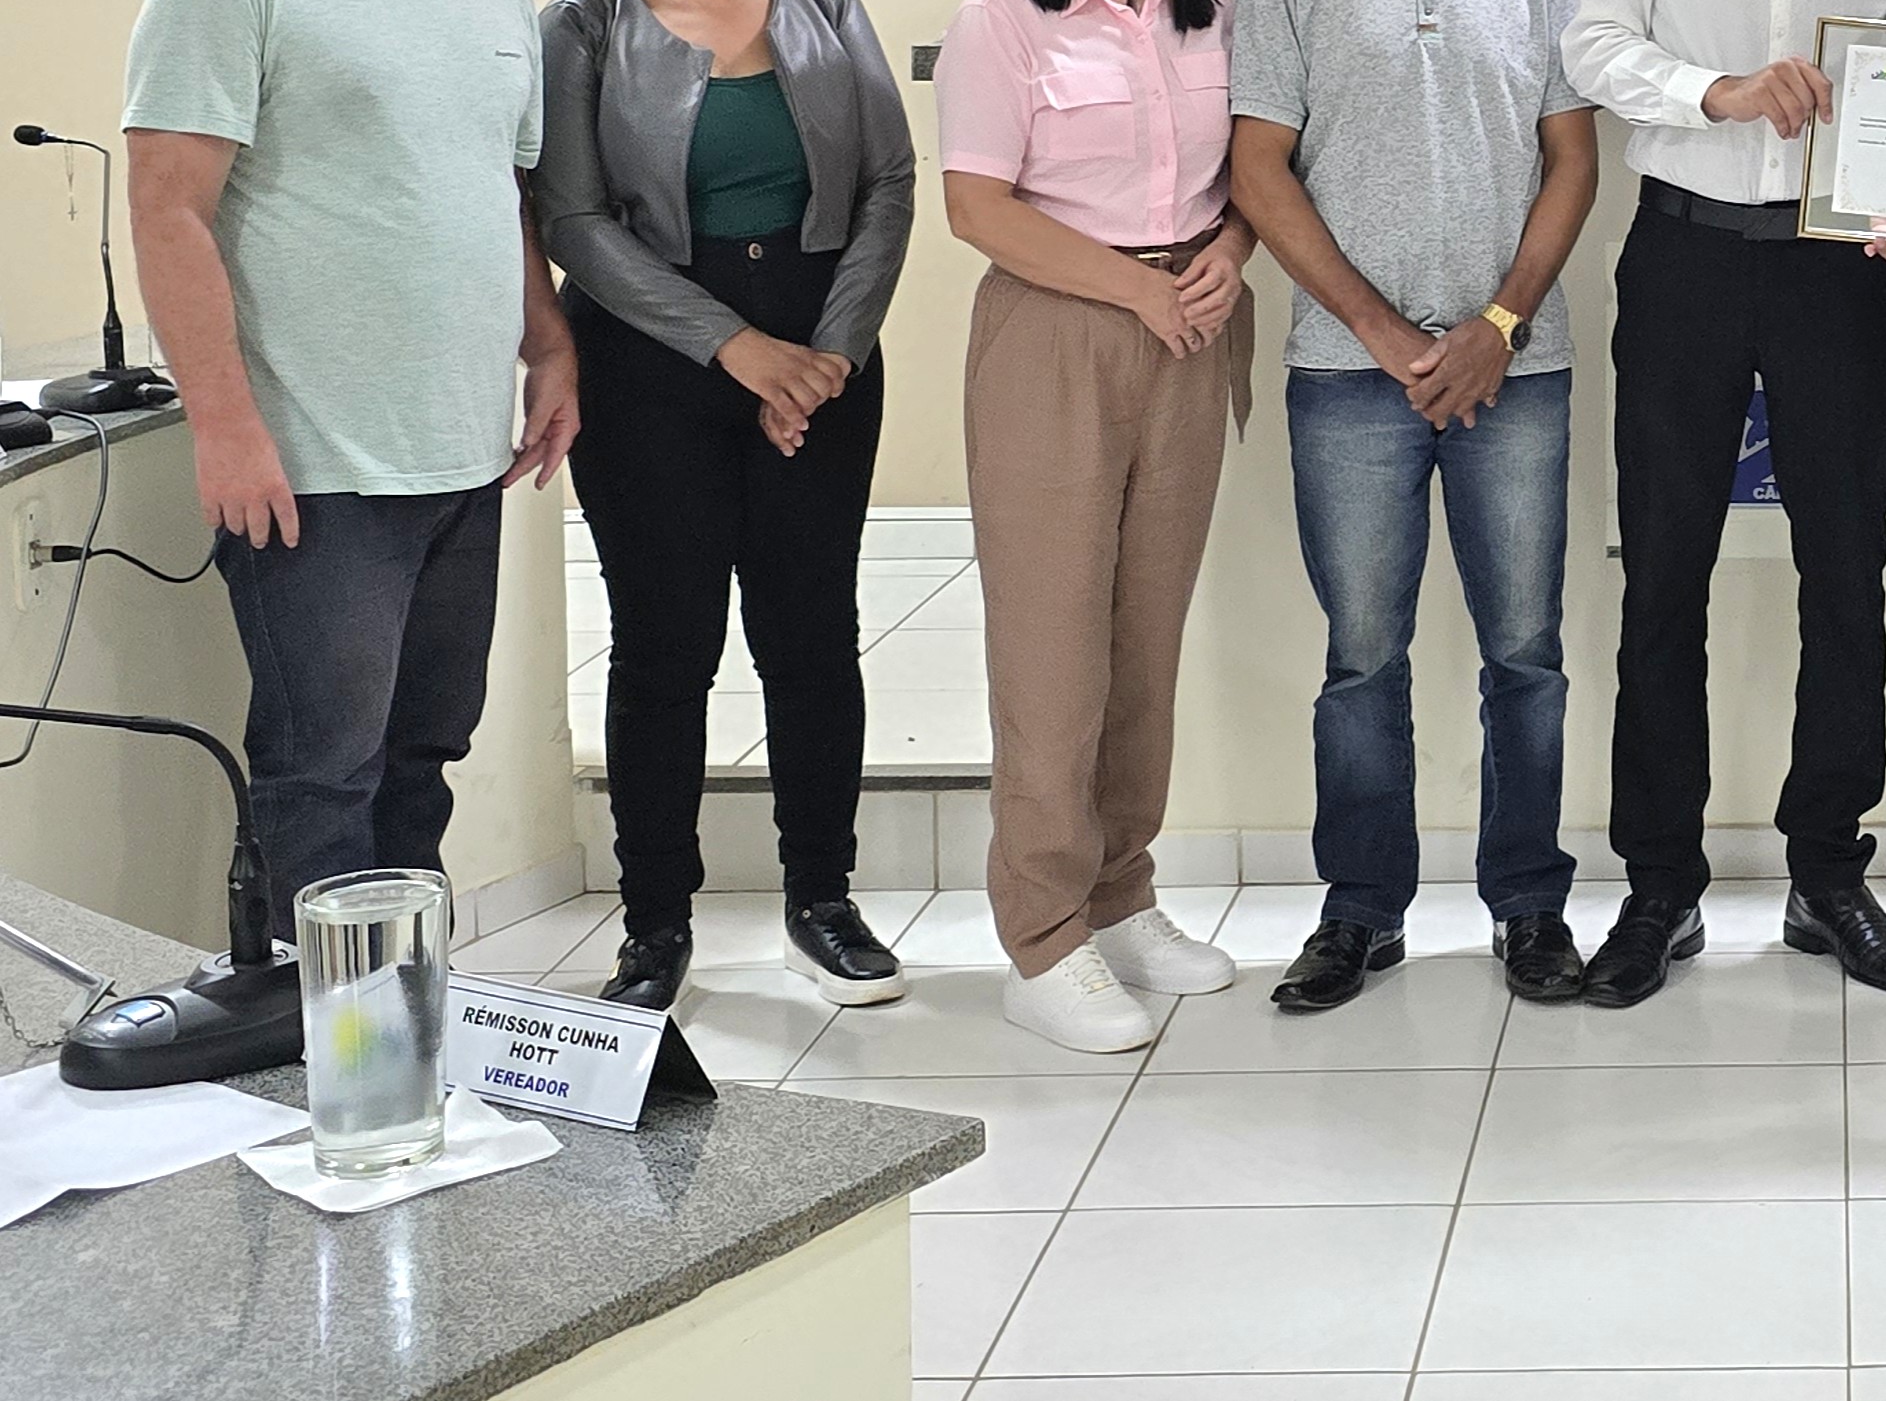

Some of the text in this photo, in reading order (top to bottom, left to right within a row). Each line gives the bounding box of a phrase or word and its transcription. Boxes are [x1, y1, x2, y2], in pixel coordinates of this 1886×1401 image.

[462, 1004, 620, 1053] RÉMISSON CUNHA
[508, 1040, 560, 1066] HOTT
[484, 1065, 570, 1098] VEREADOR
